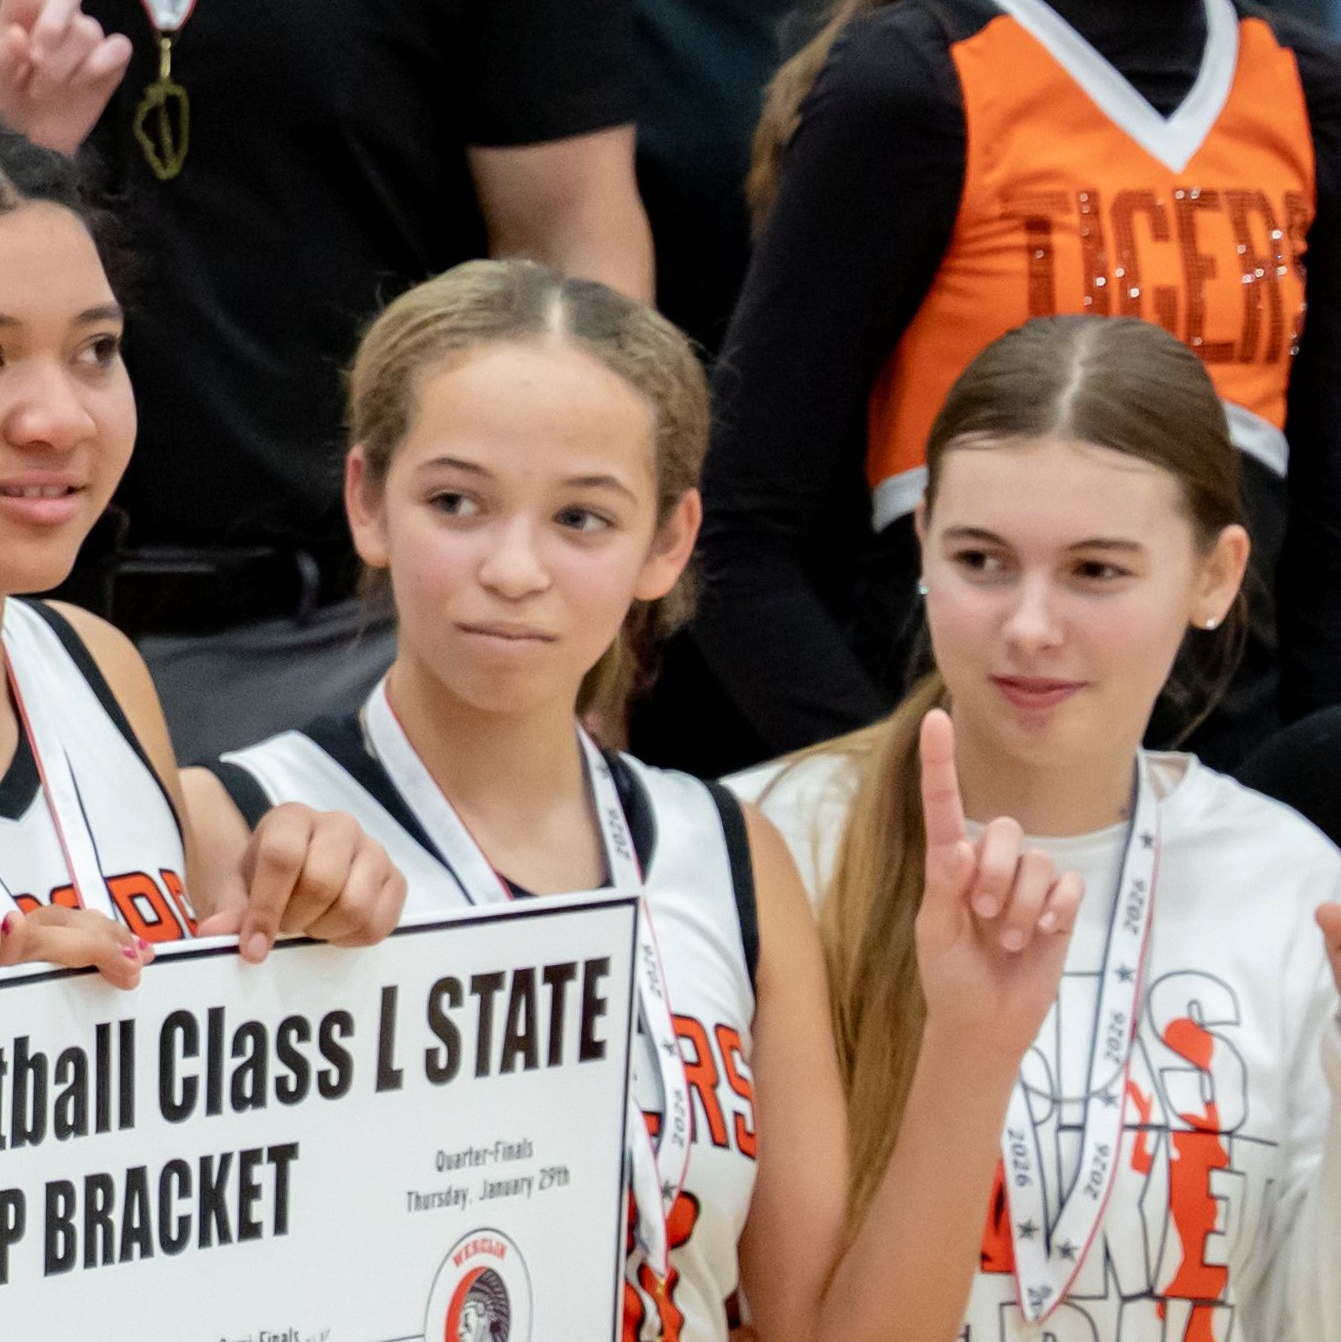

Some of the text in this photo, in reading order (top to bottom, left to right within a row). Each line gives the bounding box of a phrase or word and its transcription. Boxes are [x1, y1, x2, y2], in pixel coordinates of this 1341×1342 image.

[158, 1006, 355, 1124] Class
[375, 985, 403, 1093] L
[424, 956, 611, 1086] STATE
[406, 1165, 571, 1214] Thursday, January 29th
[435, 1138, 534, 1174] Quarter-Finals
[43, 1142, 300, 1278] BRACKET
